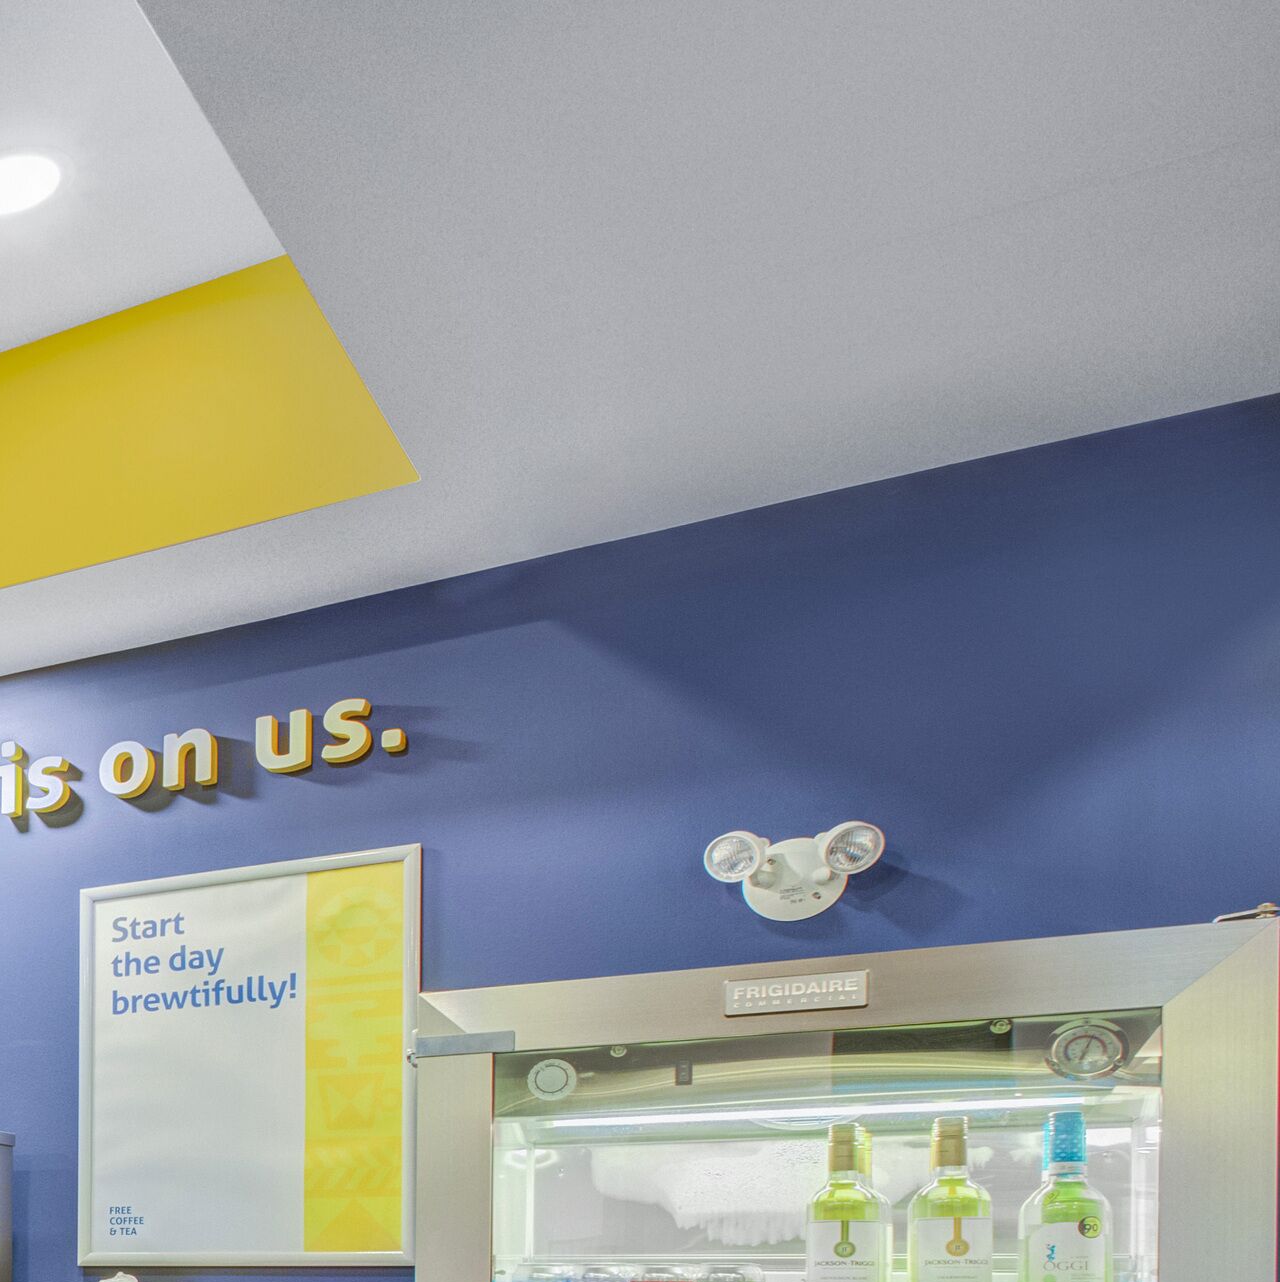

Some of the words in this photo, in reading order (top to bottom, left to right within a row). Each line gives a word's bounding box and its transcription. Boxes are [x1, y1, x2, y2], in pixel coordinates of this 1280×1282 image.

[99, 728, 218, 799] on
[256, 698, 408, 773] us.
[112, 912, 185, 943] Start
[111, 951, 161, 978] the
[169, 945, 224, 976] day
[112, 973, 297, 1015] brewtifully!
[733, 978, 859, 999] FRIGIDAIRE
[733, 994, 858, 1008] COMMERCIAL
[109, 1206, 132, 1215] FREE
[109, 1216, 144, 1226] COFFEE
[109, 1227, 117, 1236] &
[120, 1227, 137, 1236] TEA
[1042, 1260, 1089, 1271] OGGI
